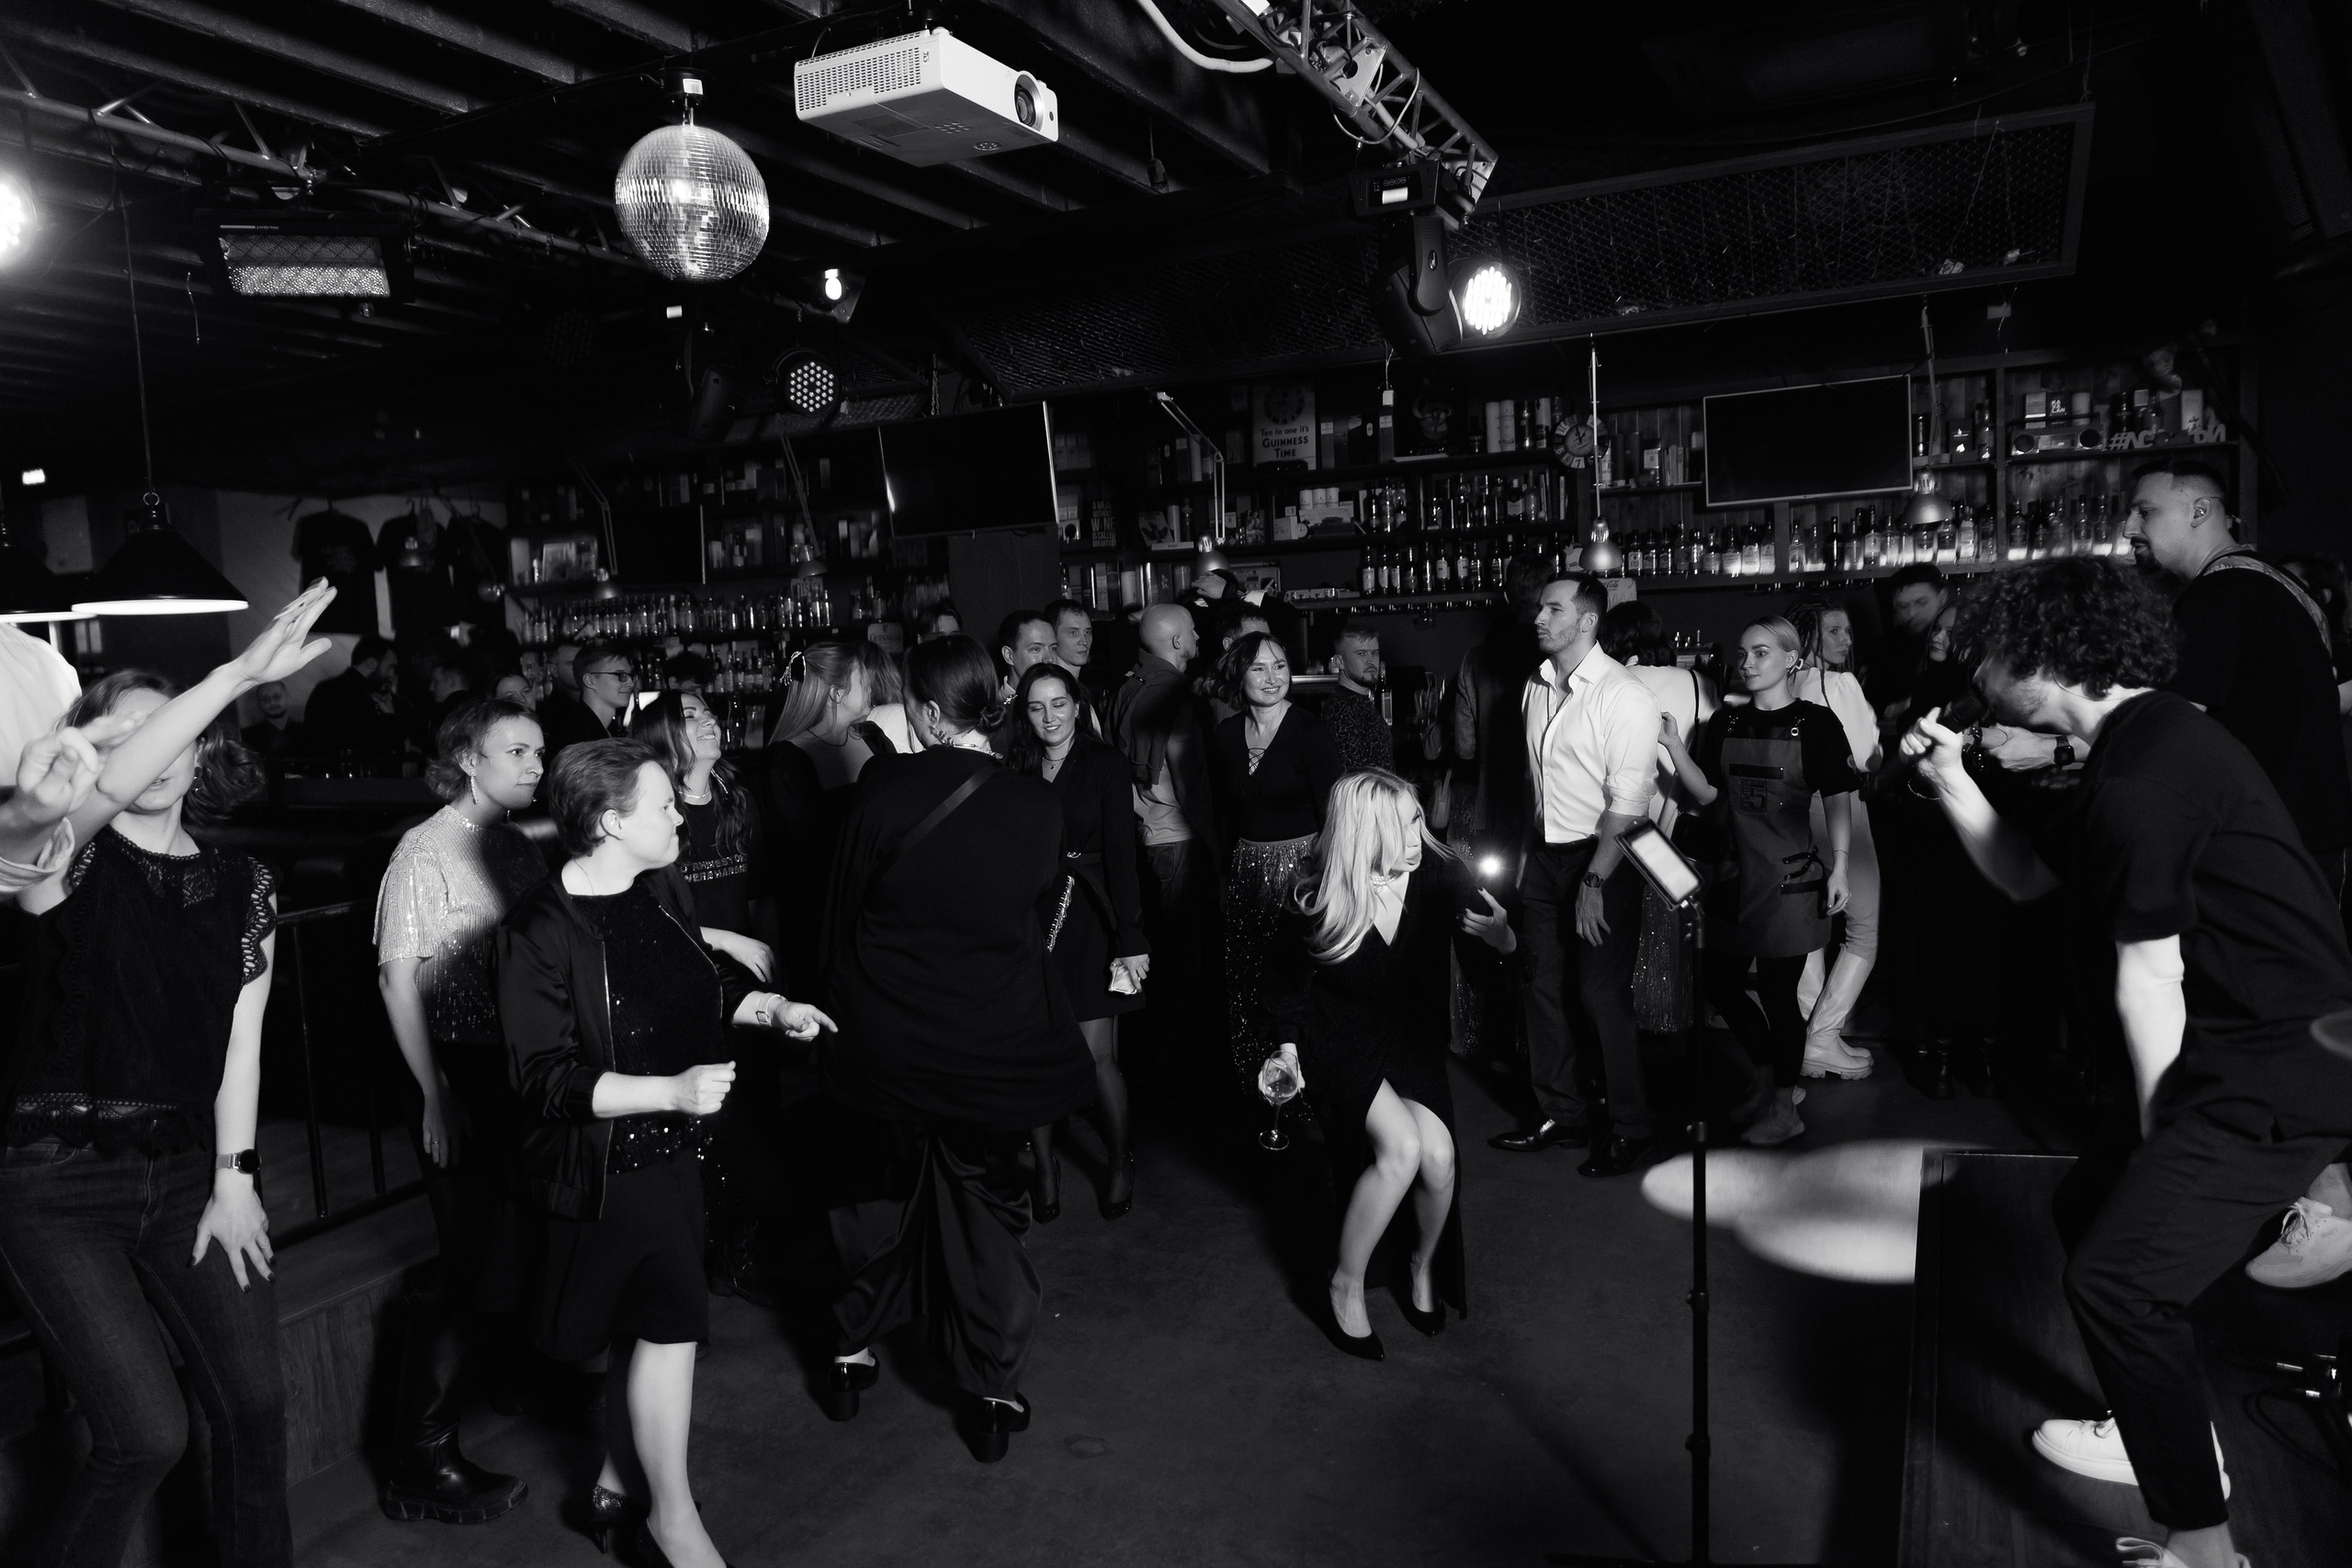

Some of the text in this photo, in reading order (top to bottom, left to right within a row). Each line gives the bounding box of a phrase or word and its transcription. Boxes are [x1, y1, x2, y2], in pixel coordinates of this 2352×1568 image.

[1260, 428, 1272, 436] Ten
[1299, 425, 1309, 434] it's
[1261, 435, 1309, 448] GUINNESS
[1274, 448, 1296, 458] TIME
[1091, 516, 1115, 532] WINE
[692, 854, 748, 872] RHINESTON
[715, 863, 748, 878] HARME
